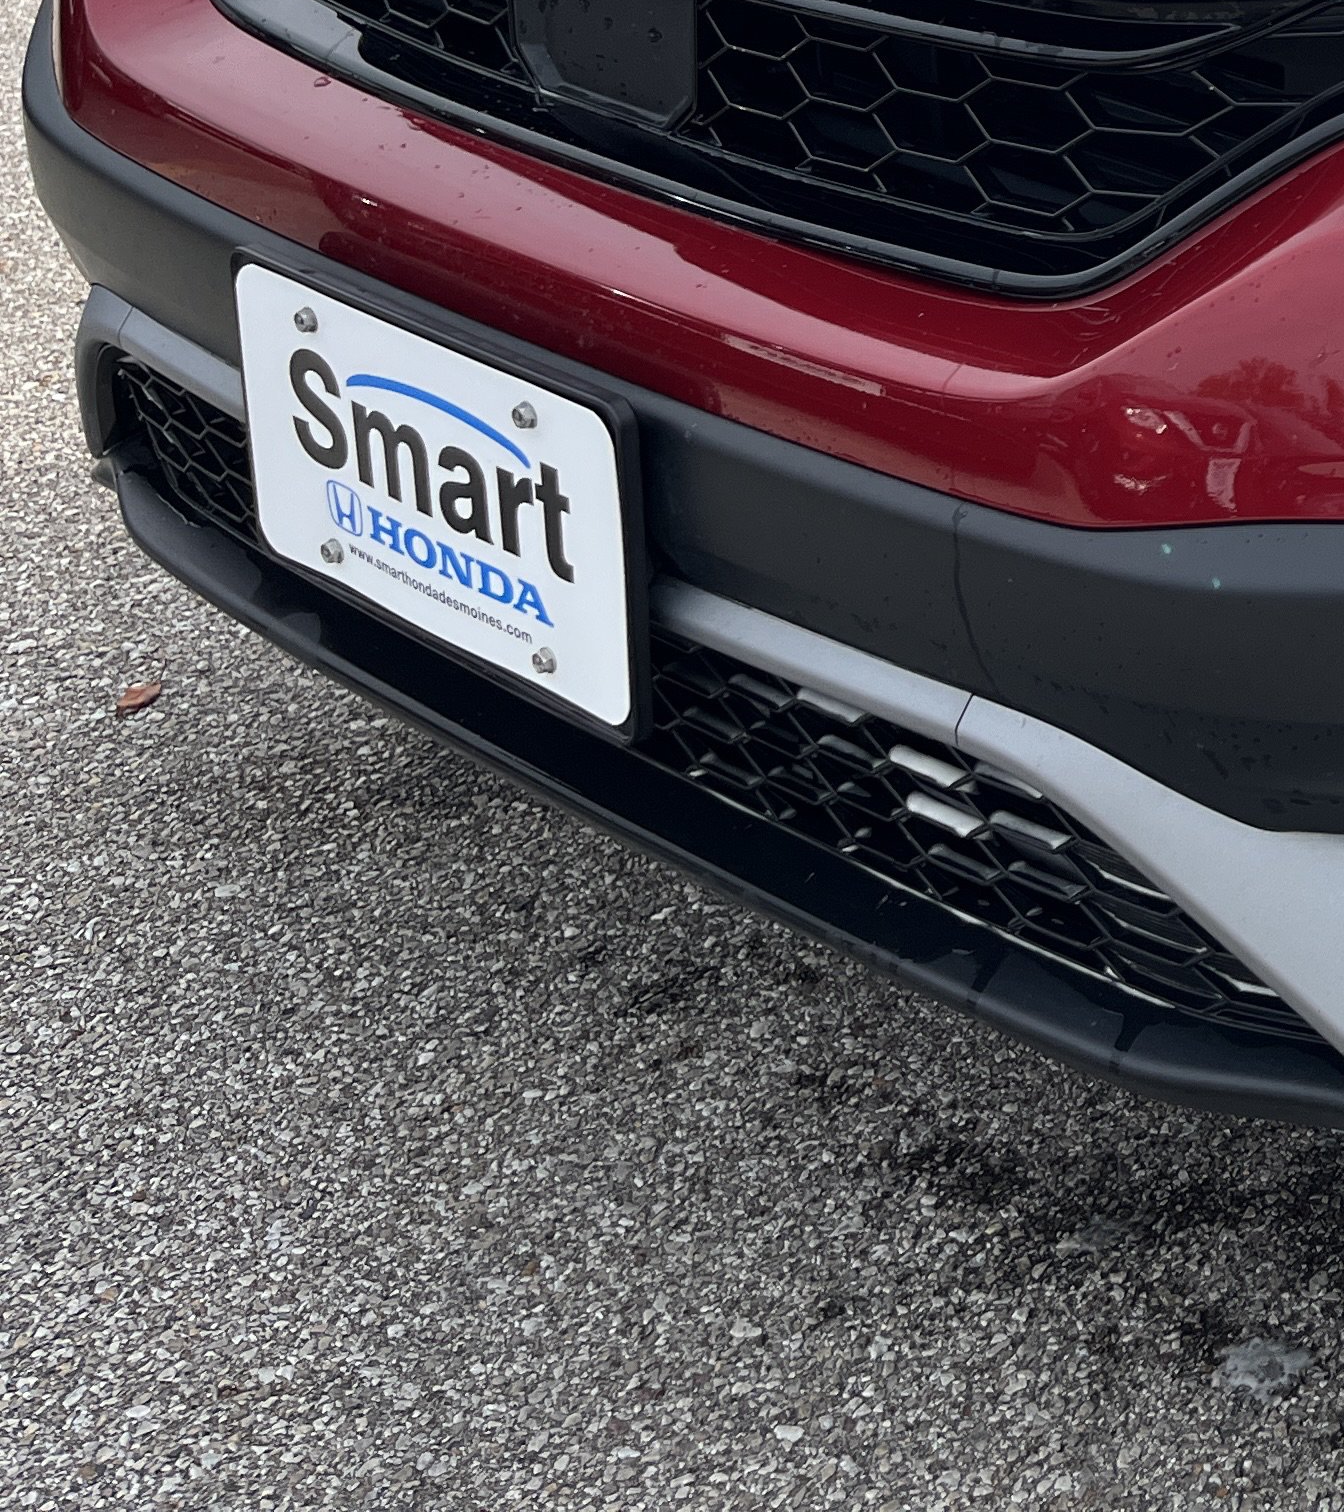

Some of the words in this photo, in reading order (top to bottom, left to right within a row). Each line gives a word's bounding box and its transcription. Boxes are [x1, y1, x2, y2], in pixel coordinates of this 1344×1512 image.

[289, 348, 575, 584] Smart
[349, 543, 533, 644] www.smarthondadesmoines.com
[367, 506, 555, 628] HONDA
